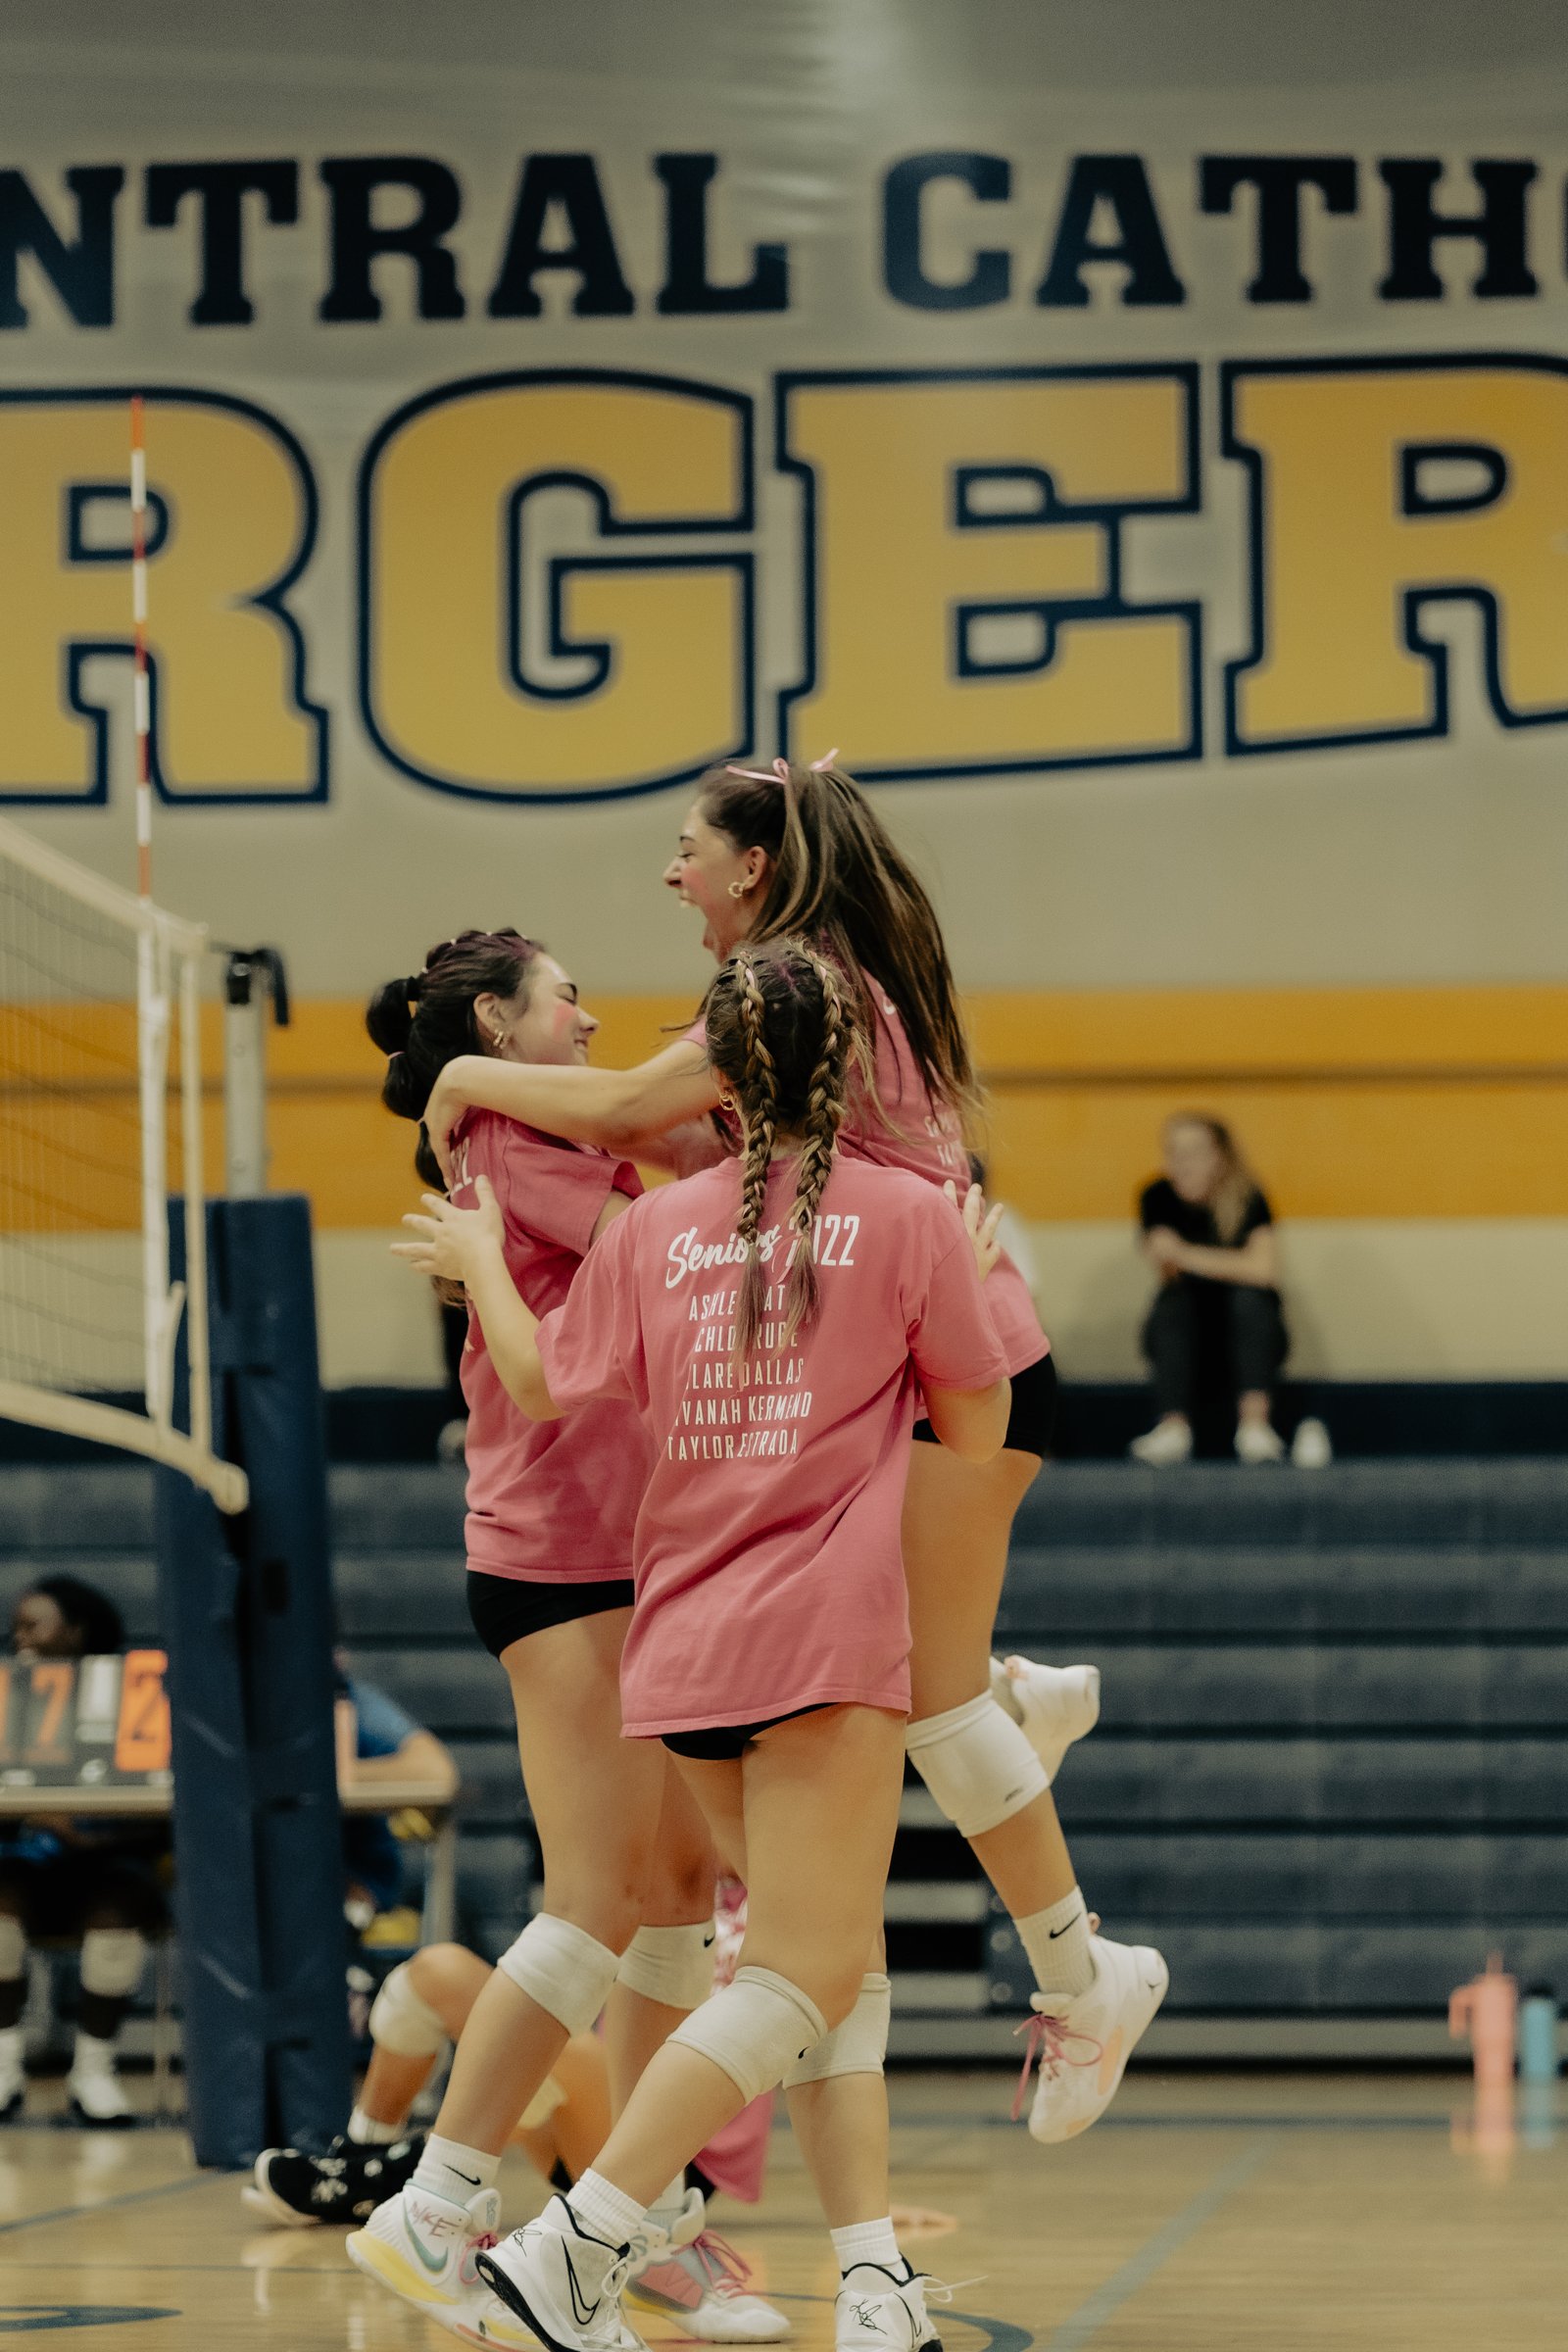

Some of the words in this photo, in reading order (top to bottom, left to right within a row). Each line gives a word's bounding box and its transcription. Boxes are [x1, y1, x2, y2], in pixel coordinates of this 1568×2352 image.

[879, 149, 1568, 313] CATH
[0, 352, 1568, 807] RGER
[689, 1290, 738, 1322] ASHLE
[694, 1325, 737, 1352] CHLO
[686, 1362, 733, 1390] LARE
[743, 1358, 804, 1387] DALLAS
[675, 1398, 742, 1427] VANAH
[667, 1434, 734, 1461] TAYLOR
[737, 1428, 798, 1457] ESTRADA
